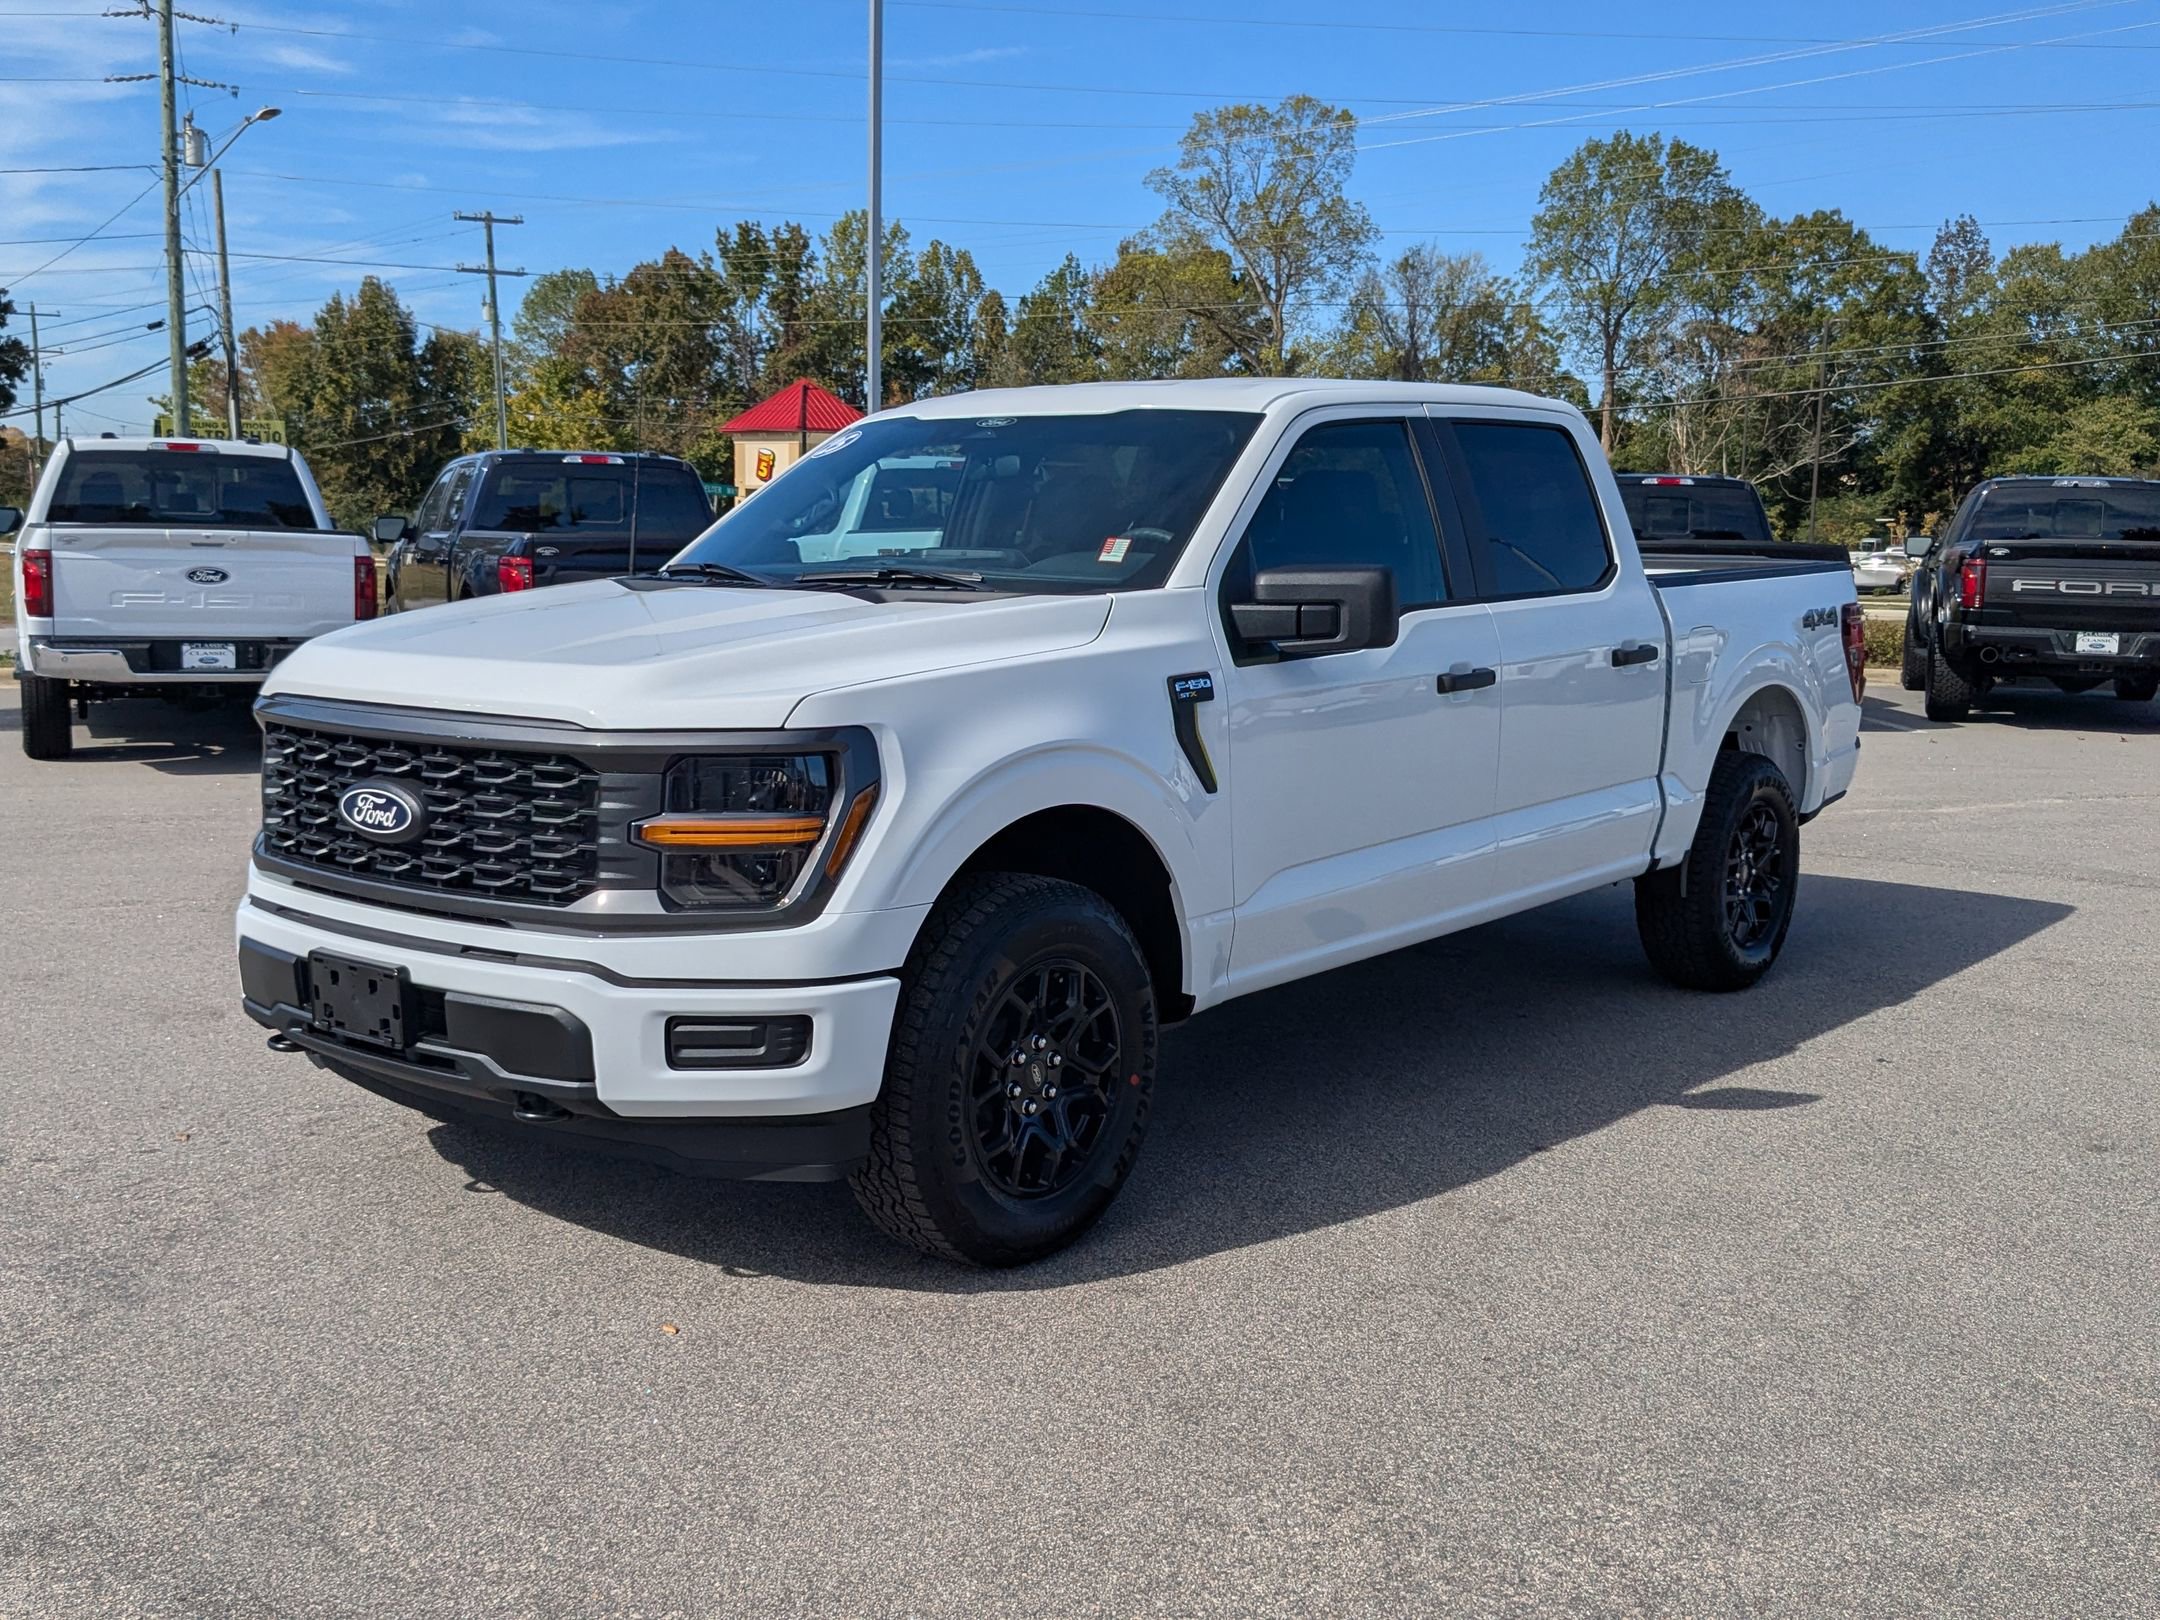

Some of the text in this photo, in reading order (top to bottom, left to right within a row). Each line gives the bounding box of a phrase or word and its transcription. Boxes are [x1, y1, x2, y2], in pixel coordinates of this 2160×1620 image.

[188, 421, 272, 431] ULING STIONS
[758, 463, 768, 478] 5
[188, 568, 224, 584] Ford
[2012, 579, 2160, 597] FOR
[109, 590, 304, 610] F-150
[1175, 678, 1212, 692] F-150
[1179, 690, 1198, 699] STX
[353, 793, 398, 828] Ford
